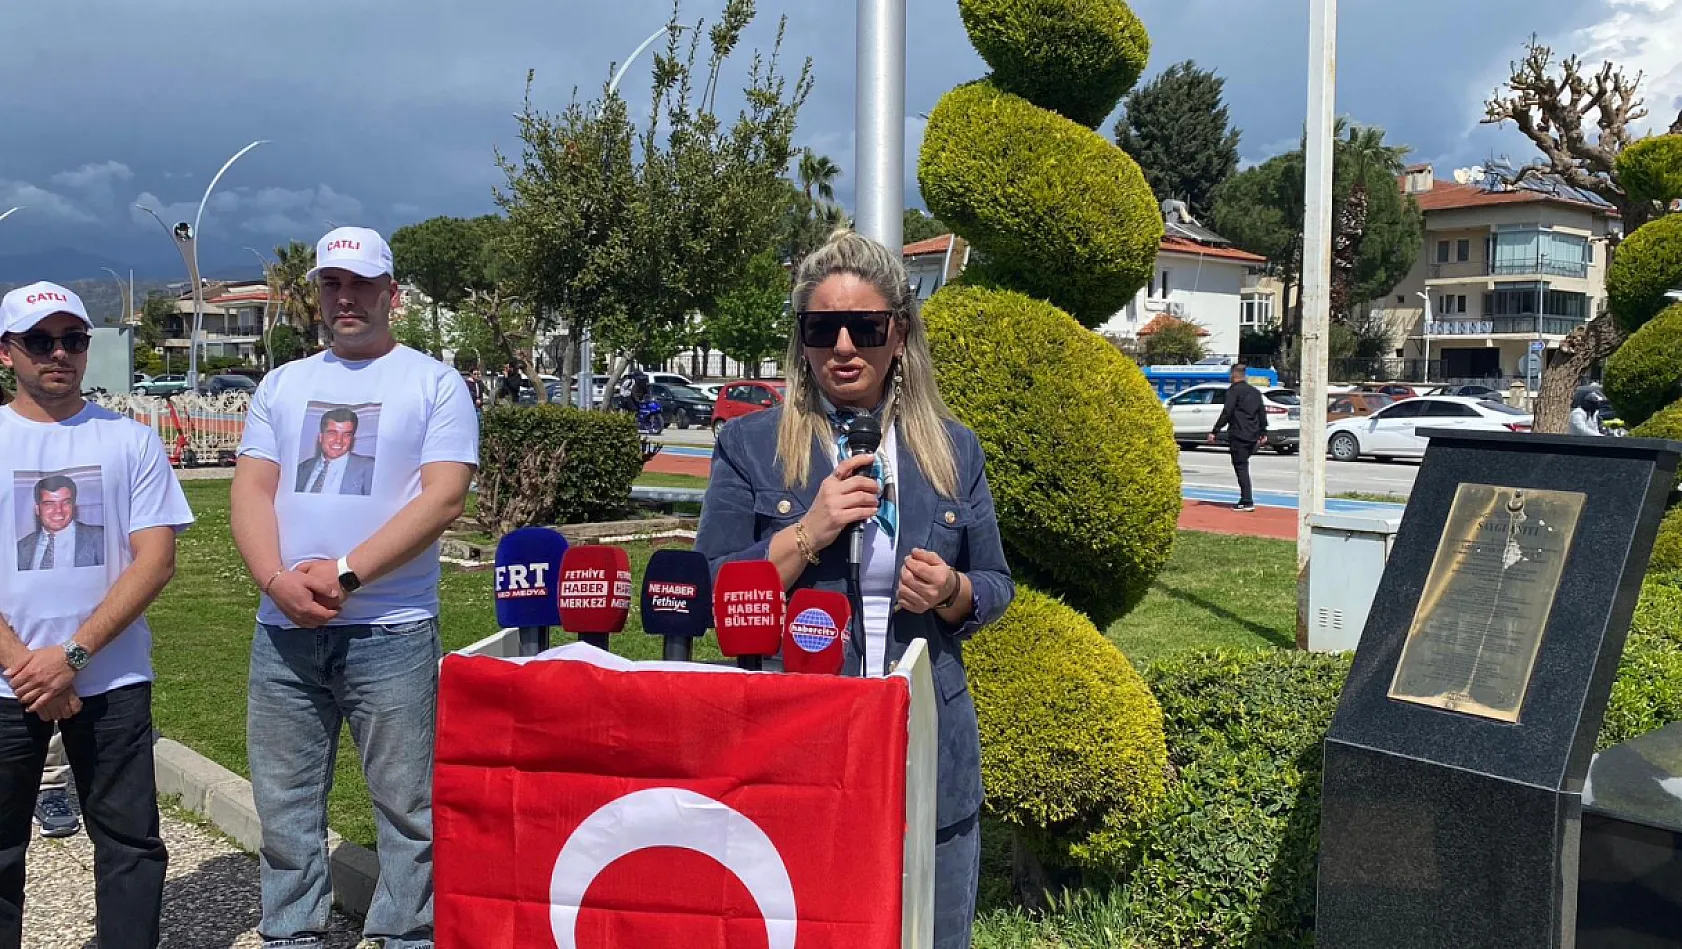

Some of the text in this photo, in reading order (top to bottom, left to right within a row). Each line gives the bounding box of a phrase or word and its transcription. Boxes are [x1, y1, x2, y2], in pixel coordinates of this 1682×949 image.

[495, 563, 549, 591] FRT
[565, 568, 605, 579] FETHİYE
[511, 588, 546, 598] MEDYA
[563, 583, 604, 593] HABER
[724, 588, 773, 602] FETHİYE
[560, 597, 607, 608] MERKEZİ
[652, 595, 687, 609] Fethiye
[728, 603, 770, 614] HABER
[724, 613, 774, 627] BÜLTENİ
